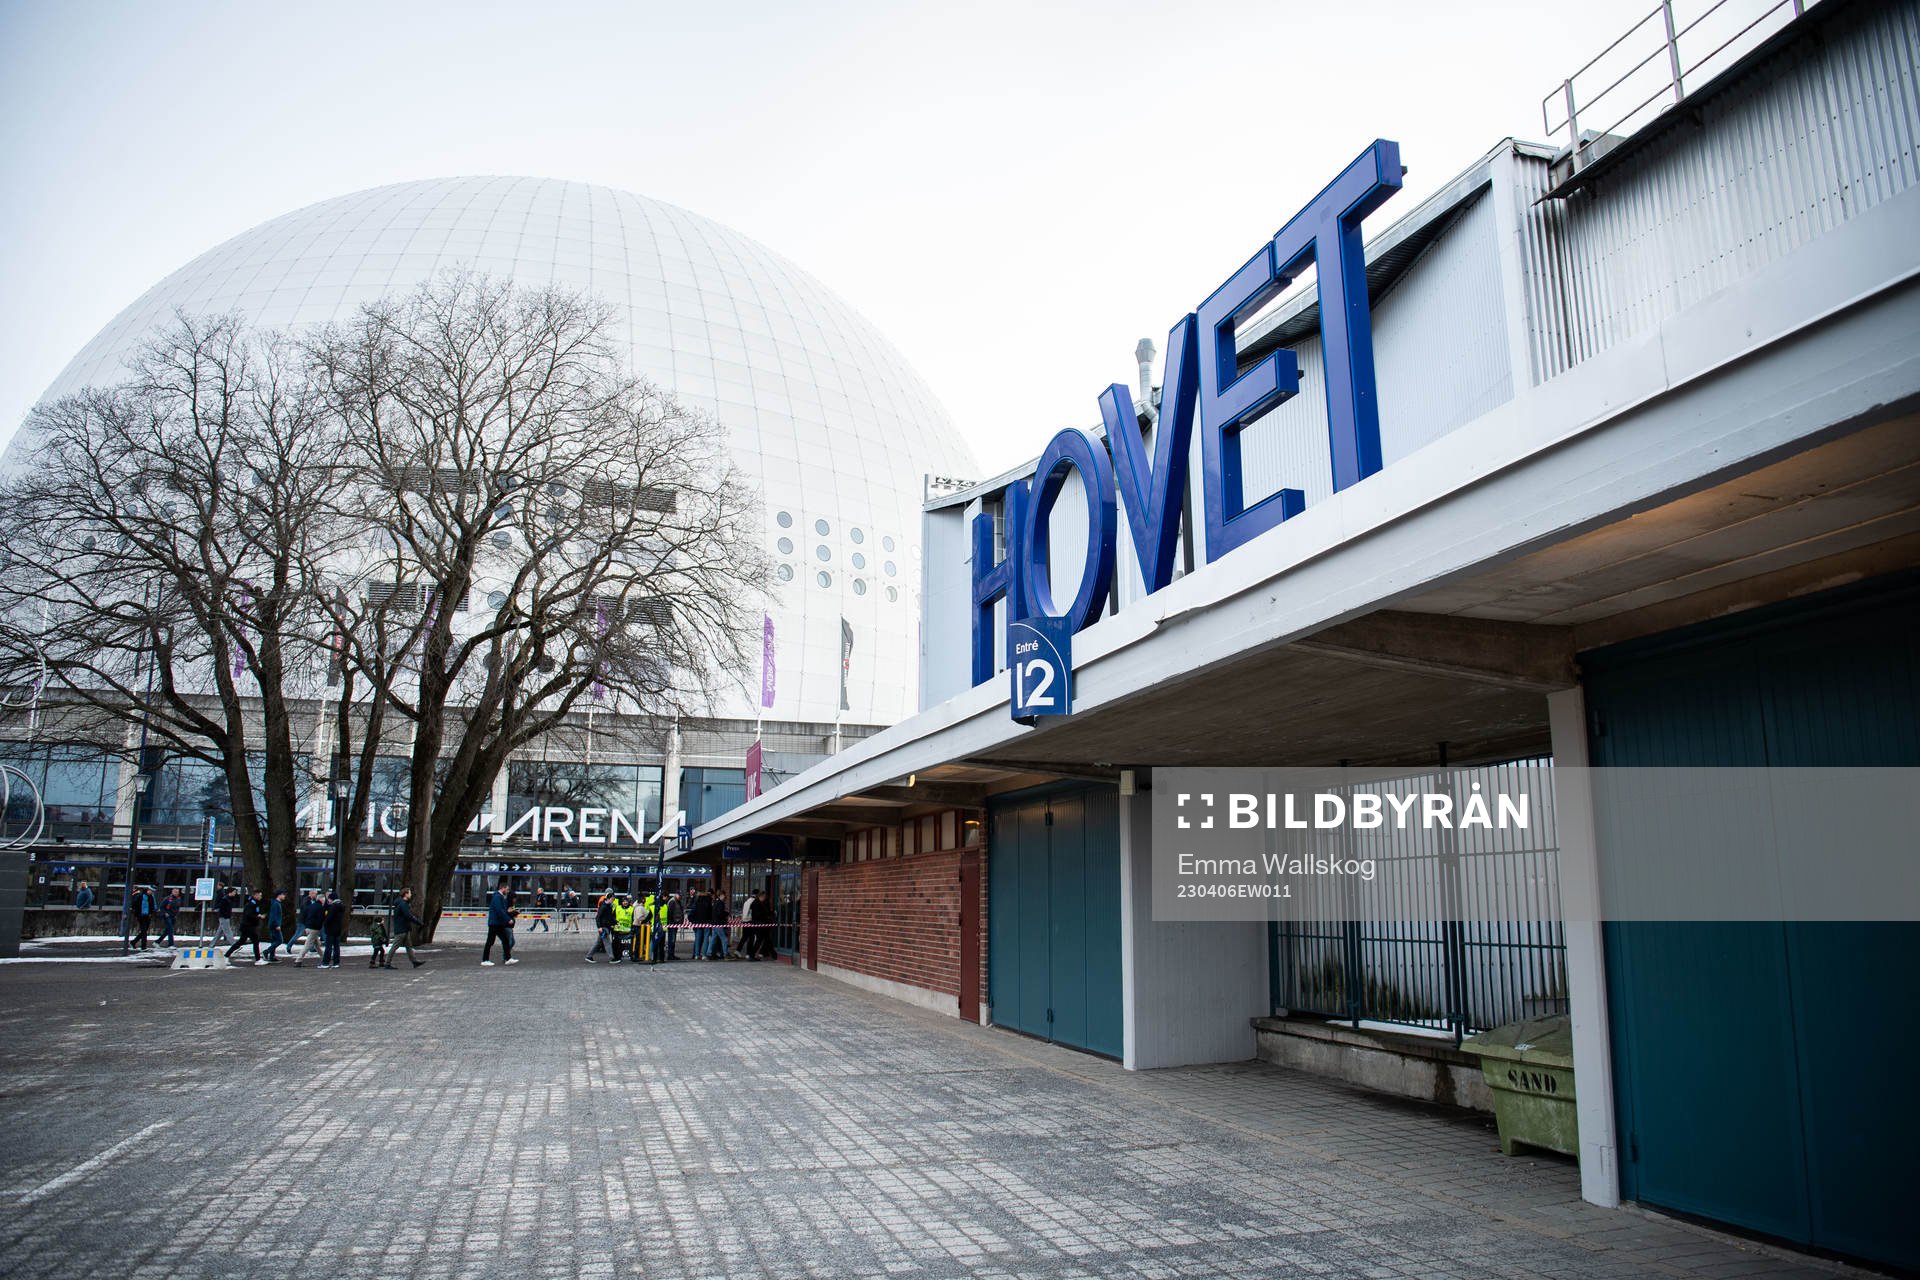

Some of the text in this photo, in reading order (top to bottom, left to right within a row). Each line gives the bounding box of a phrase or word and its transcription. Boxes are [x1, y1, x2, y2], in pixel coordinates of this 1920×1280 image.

[972, 138, 1403, 688] HOVET
[1016, 640, 1039, 655] Entré
[1016, 659, 1054, 709] 12
[500, 806, 686, 844] ARENA
[549, 864, 572, 873] Entré
[1507, 1069, 1557, 1094] SAND
